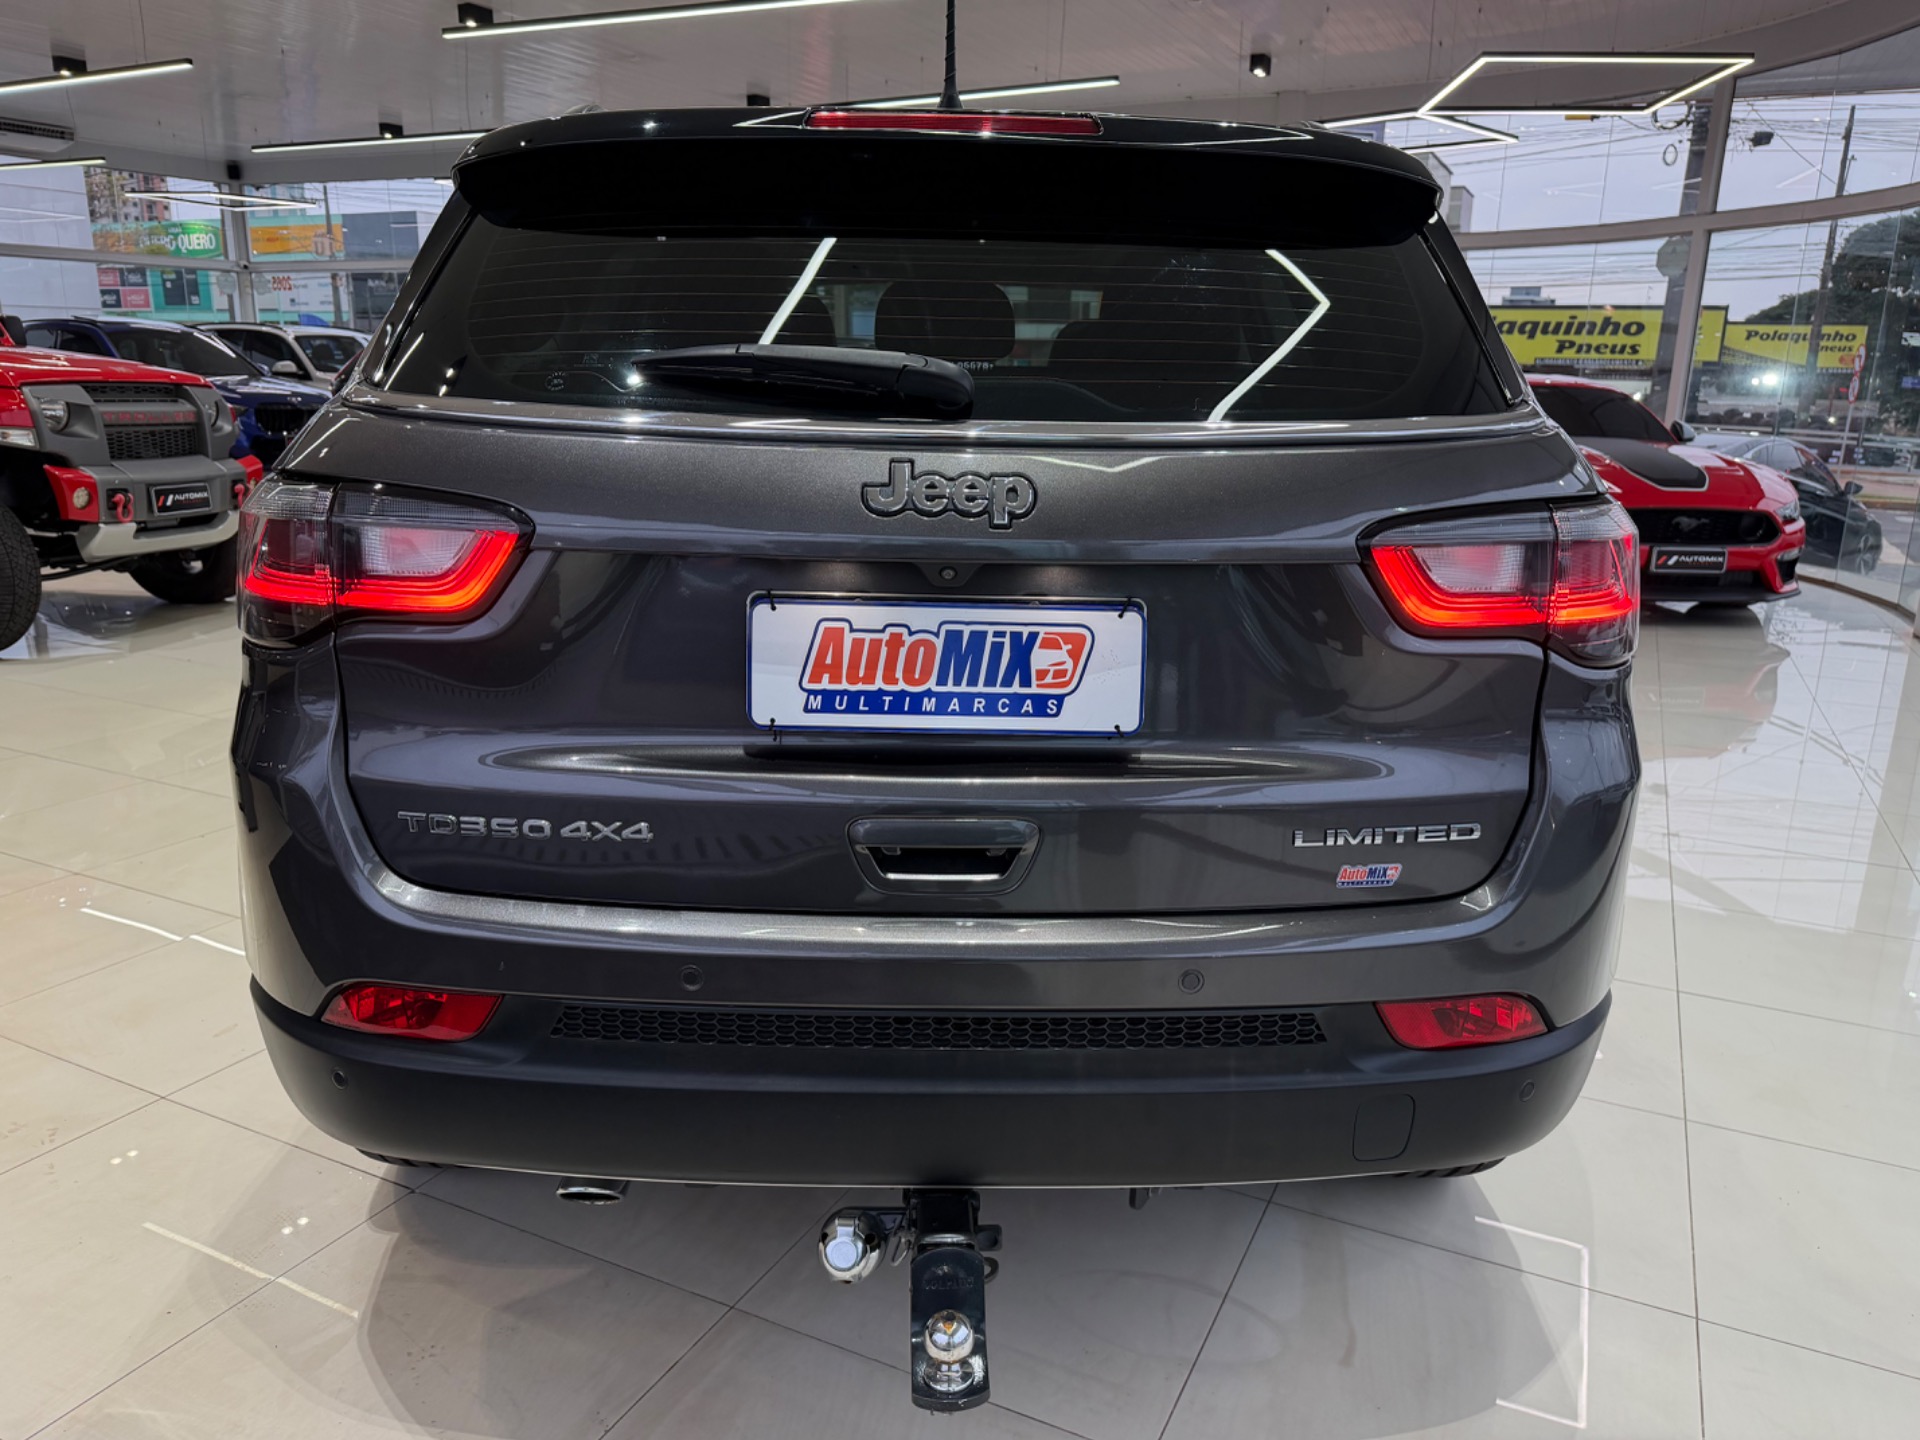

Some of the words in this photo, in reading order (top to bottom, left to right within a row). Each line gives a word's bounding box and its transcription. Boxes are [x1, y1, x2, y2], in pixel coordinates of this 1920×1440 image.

[178, 233, 216, 253] QUERO
[1492, 315, 1646, 340] aquinho
[1745, 329, 1857, 344] Polaqunho
[1555, 339, 1641, 355] Pneus
[1819, 344, 1855, 353] neus
[862, 457, 1038, 531] Jeep
[807, 694, 1059, 714] MULTIMARCAS
[397, 811, 552, 840] TD350
[1293, 823, 1481, 847] LIMITED
